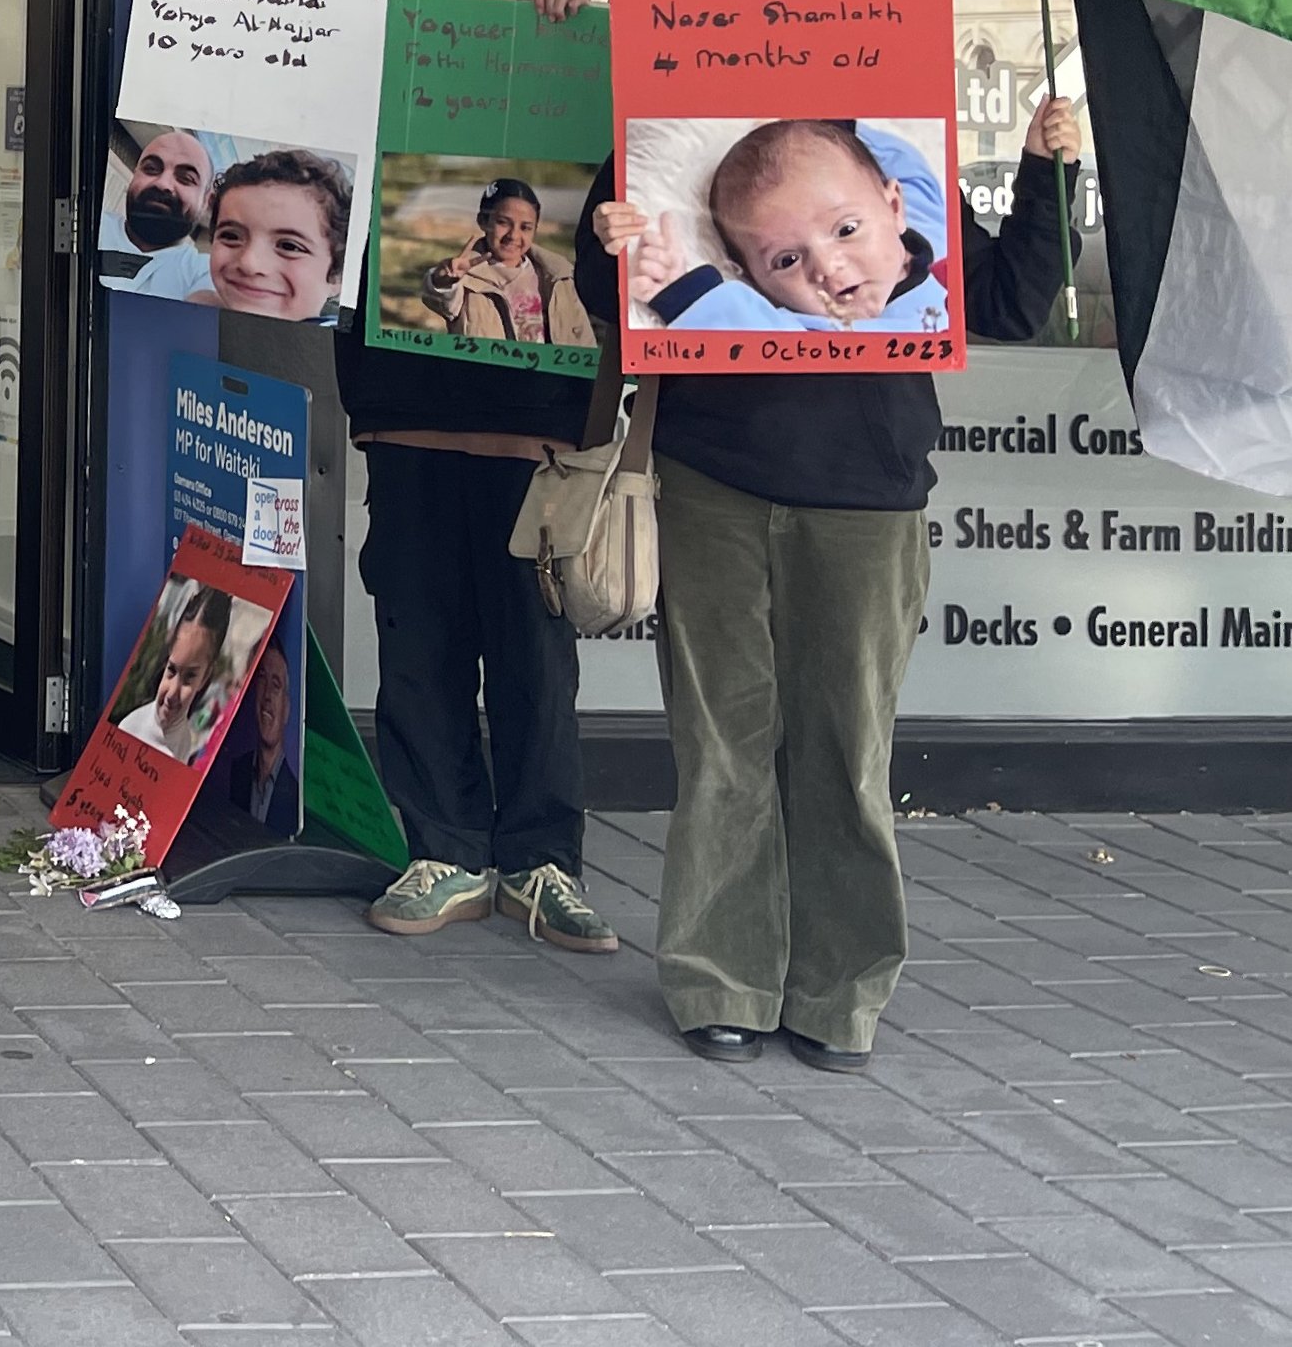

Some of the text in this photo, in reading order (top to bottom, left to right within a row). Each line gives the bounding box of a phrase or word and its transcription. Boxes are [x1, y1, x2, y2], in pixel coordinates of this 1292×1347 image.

[148, 32, 307, 67] 10 years old
[696, 40, 811, 69] months
[833, 47, 881, 69] old
[553, 348, 599, 368] 202
[761, 339, 867, 361] October
[176, 387, 293, 458] Miles Anderson
[938, 413, 1144, 455] mercial Cons
[175, 427, 261, 479] MP for Waitaki
[254, 509, 261, 522] a
[274, 496, 300, 512] cross
[283, 517, 300, 534] the
[955, 507, 1051, 550] Sheds
[1064, 509, 1090, 551] &
[1102, 509, 1181, 552] Farm
[1194, 511, 1292, 553] Buildi
[944, 604, 1038, 646] Decks
[1088, 606, 1208, 648] General
